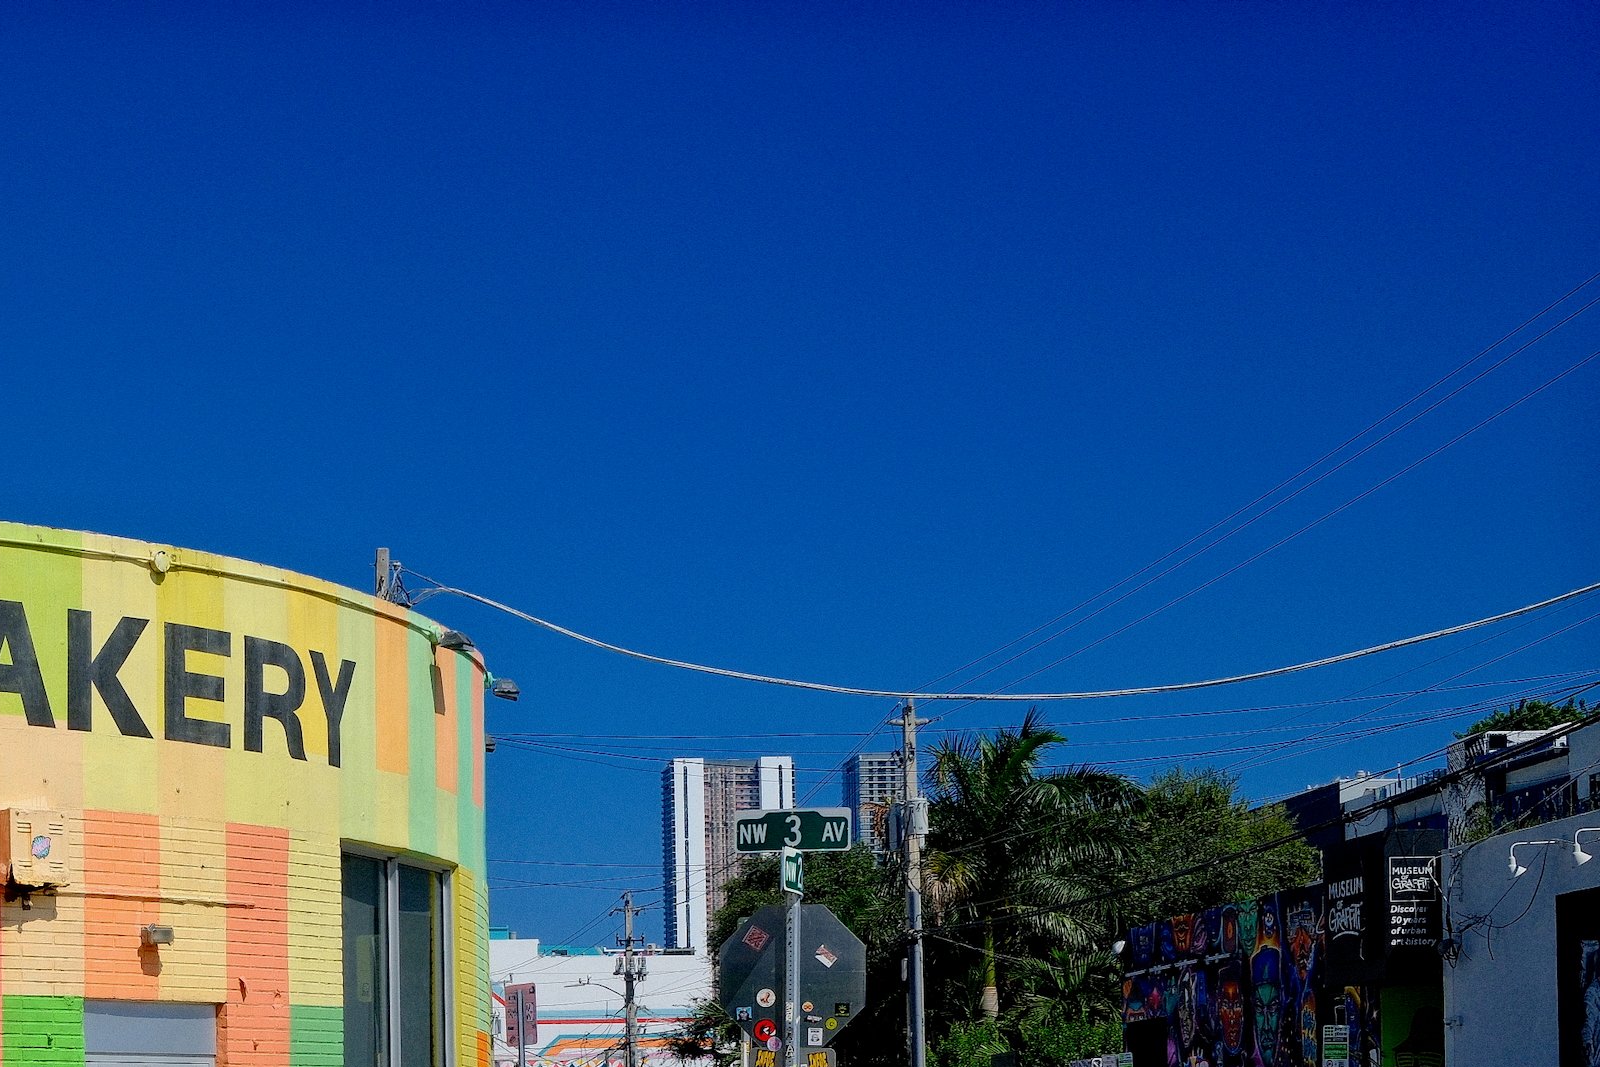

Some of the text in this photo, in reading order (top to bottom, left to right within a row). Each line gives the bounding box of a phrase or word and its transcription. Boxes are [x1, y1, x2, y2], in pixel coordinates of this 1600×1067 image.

[739, 815, 846, 847] NW 3 AV
[1392, 867, 1433, 875] MUSEUM
[1328, 876, 1363, 900] MUSEUM
[1390, 905, 1427, 913] Discover
[1390, 916, 1427, 926] 50 years
[1390, 926, 1427, 935] of urban
[1390, 938, 1437, 947] art history
